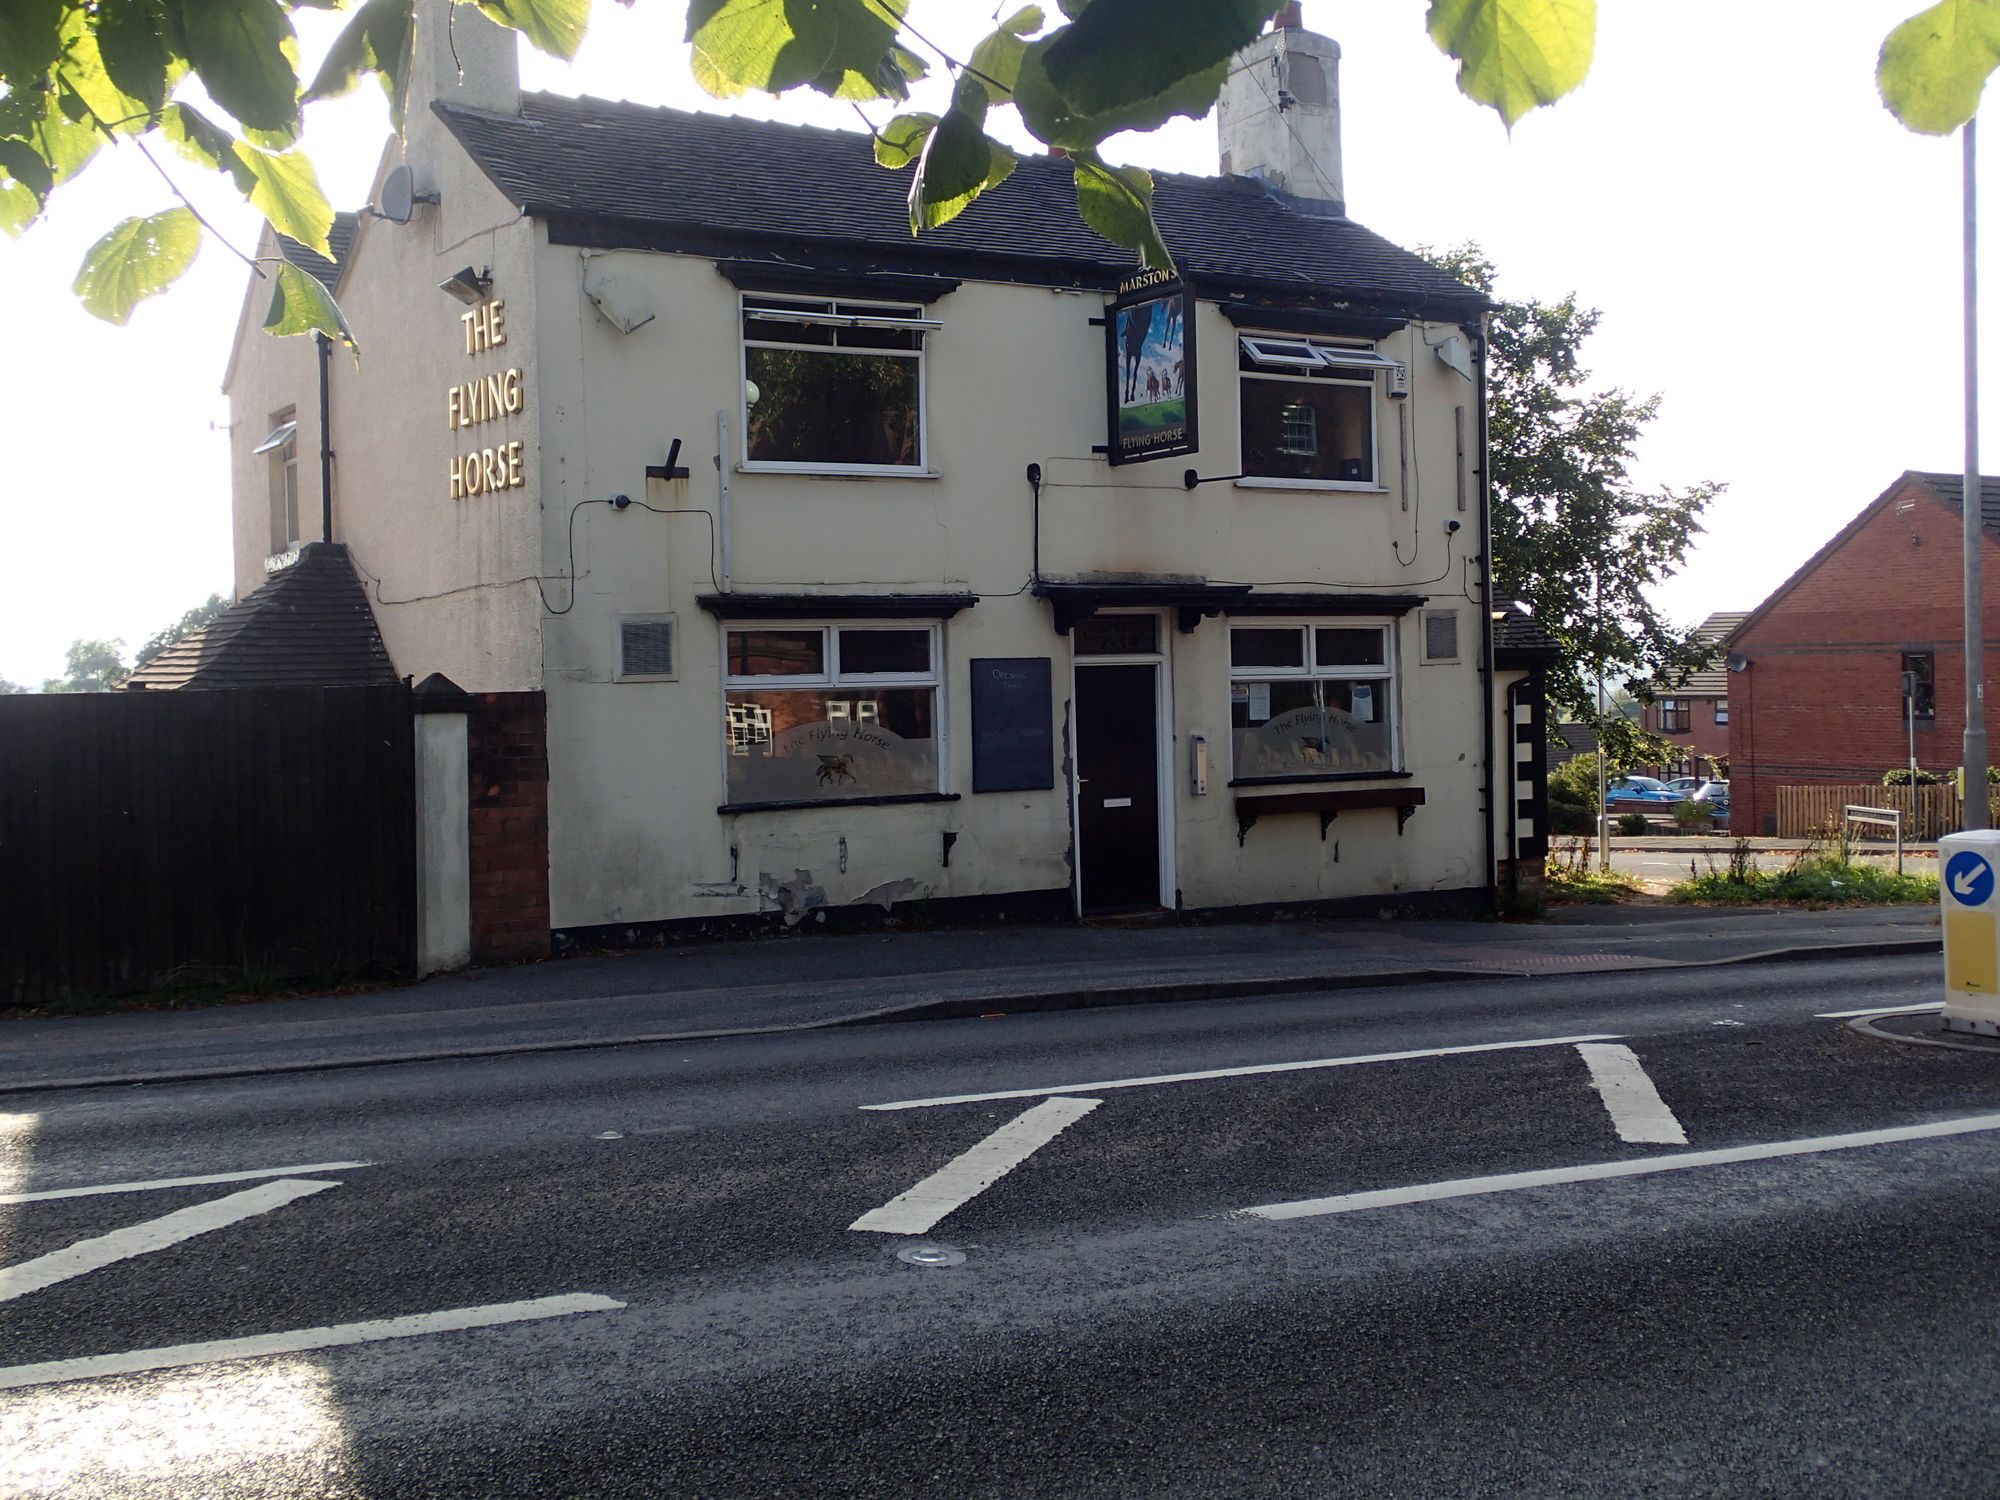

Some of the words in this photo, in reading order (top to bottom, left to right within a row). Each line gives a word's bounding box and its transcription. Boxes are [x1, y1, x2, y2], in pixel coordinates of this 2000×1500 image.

[1120, 268, 1177, 294] MARSTONS
[461, 300, 507, 355] THE
[449, 368, 523, 431] FLYING
[1123, 434, 1151, 449] FLYING
[1153, 428, 1183, 444] HORSE
[450, 440, 525, 499] HORSE
[808, 726, 848, 742] Flyig
[853, 727, 890, 750] Horse
